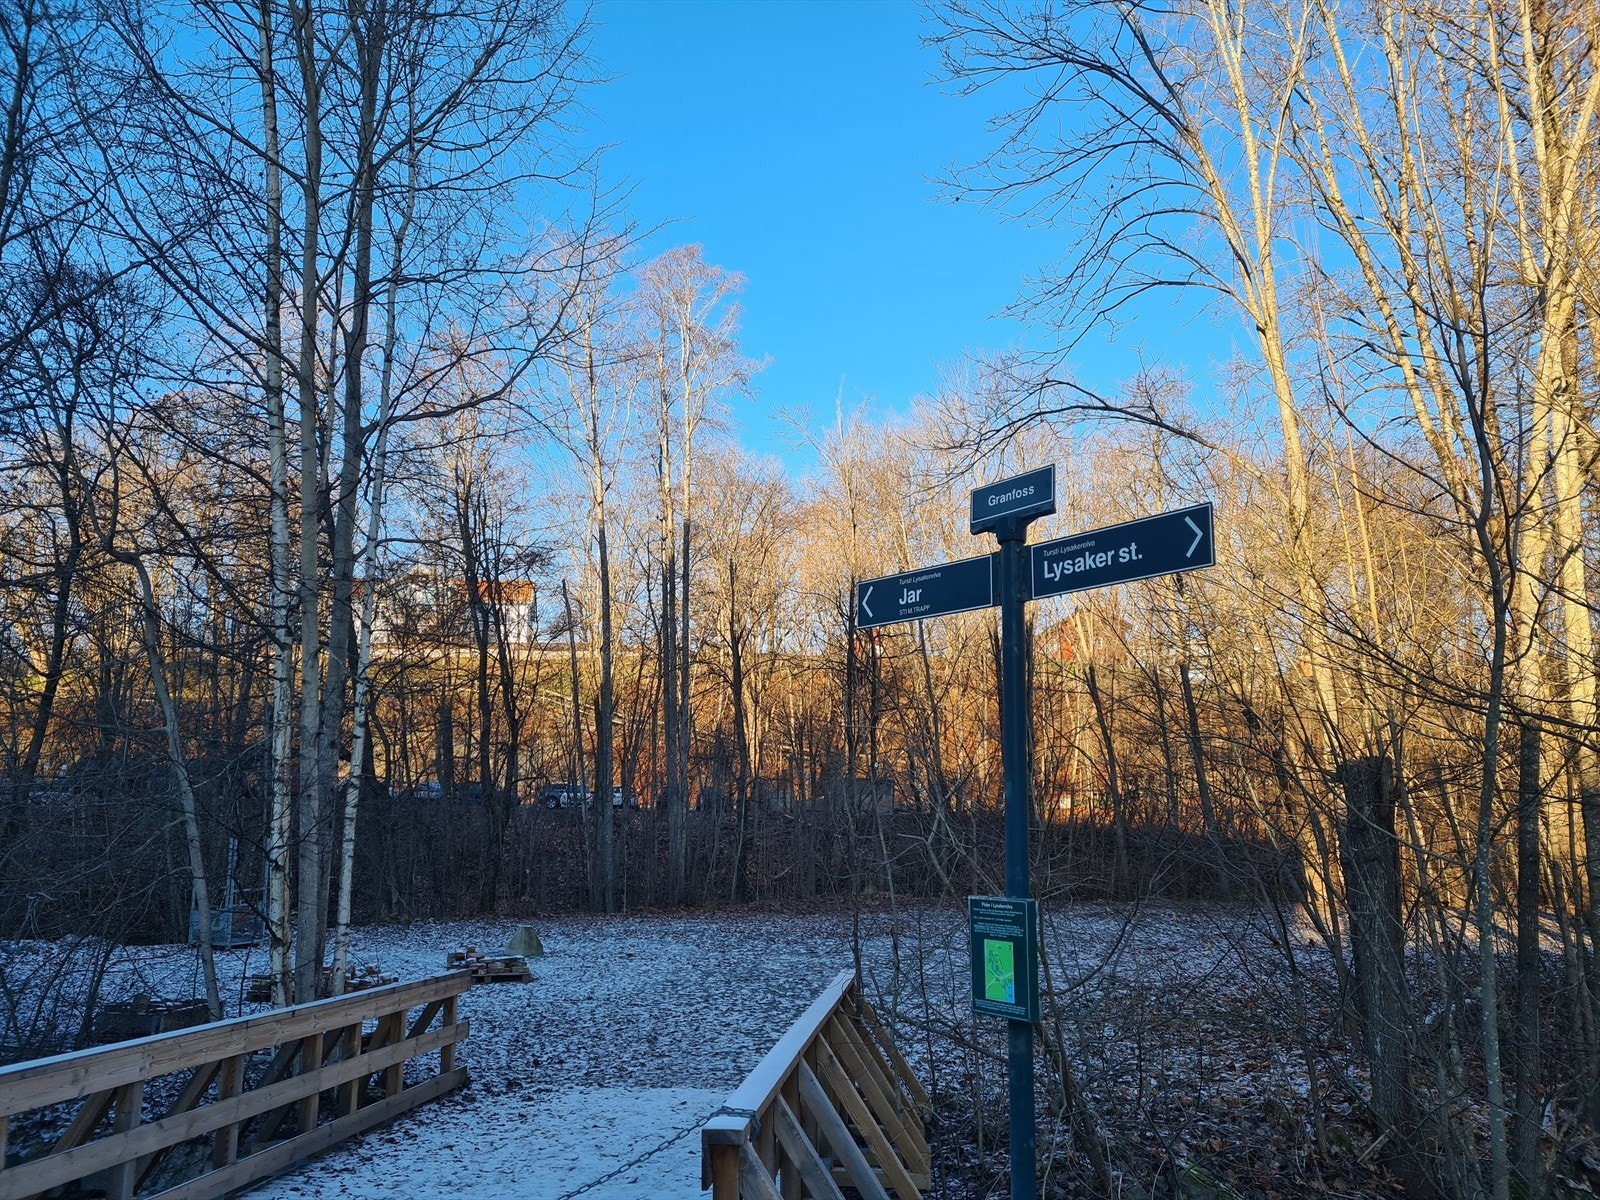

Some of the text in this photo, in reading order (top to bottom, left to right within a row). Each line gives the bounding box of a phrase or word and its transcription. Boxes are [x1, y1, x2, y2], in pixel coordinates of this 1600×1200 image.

[988, 485, 1035, 506] Granfoss
[1044, 542, 1143, 582] Lysaker st.
[899, 588, 922, 605] Jar
